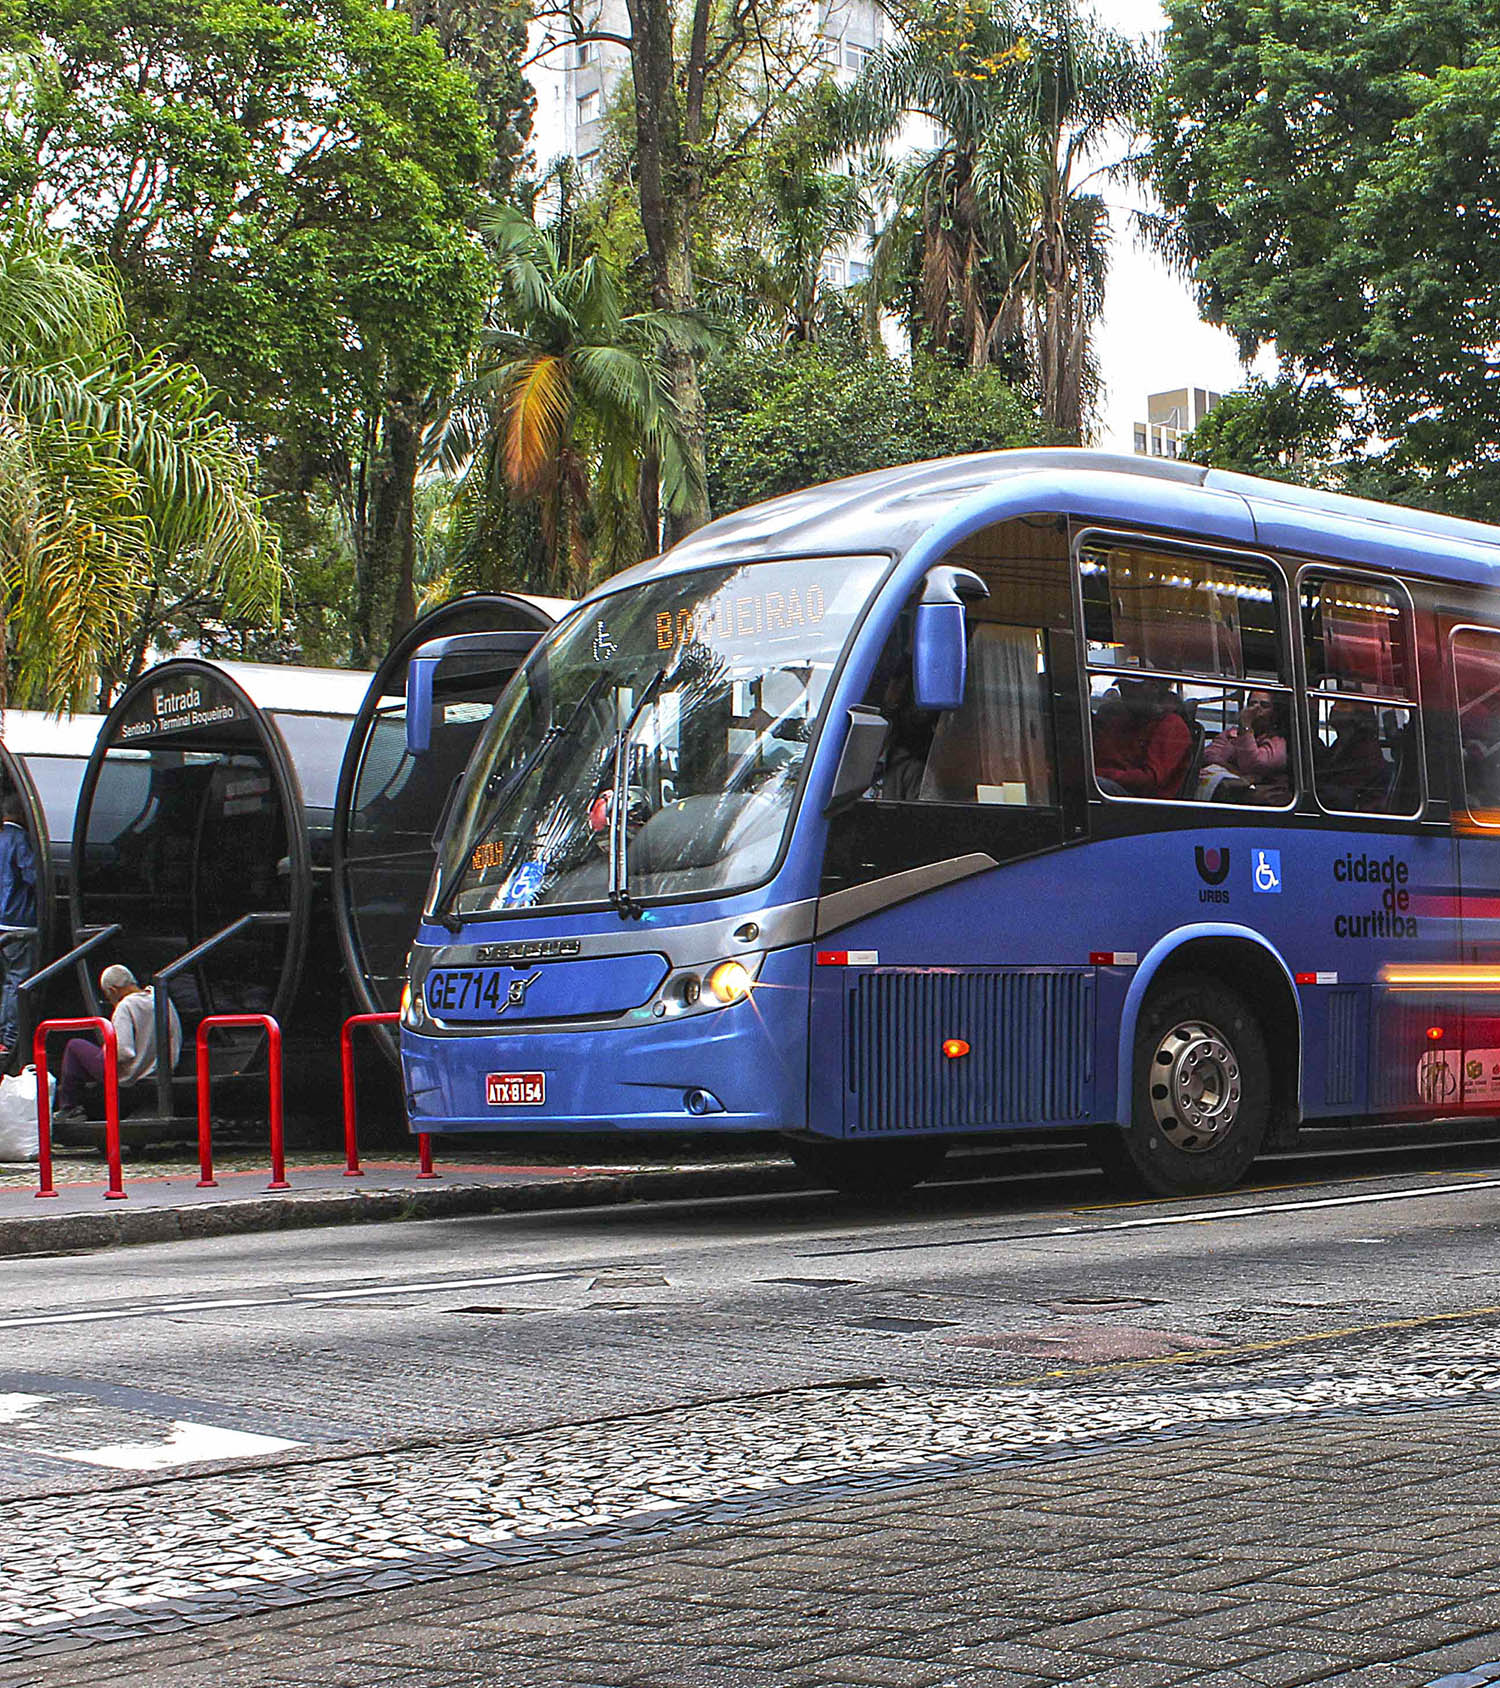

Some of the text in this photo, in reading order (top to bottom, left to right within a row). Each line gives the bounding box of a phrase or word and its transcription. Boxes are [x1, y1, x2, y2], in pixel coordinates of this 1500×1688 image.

[155, 687, 201, 716] Entrada
[121, 704, 234, 738] Sentido Terminal Boqueirão
[1333, 852, 1409, 884] cidade
[1199, 889, 1230, 904] URBS
[1382, 884, 1410, 913] de
[1334, 909, 1418, 938] curitiba
[429, 971, 501, 1011] GE714
